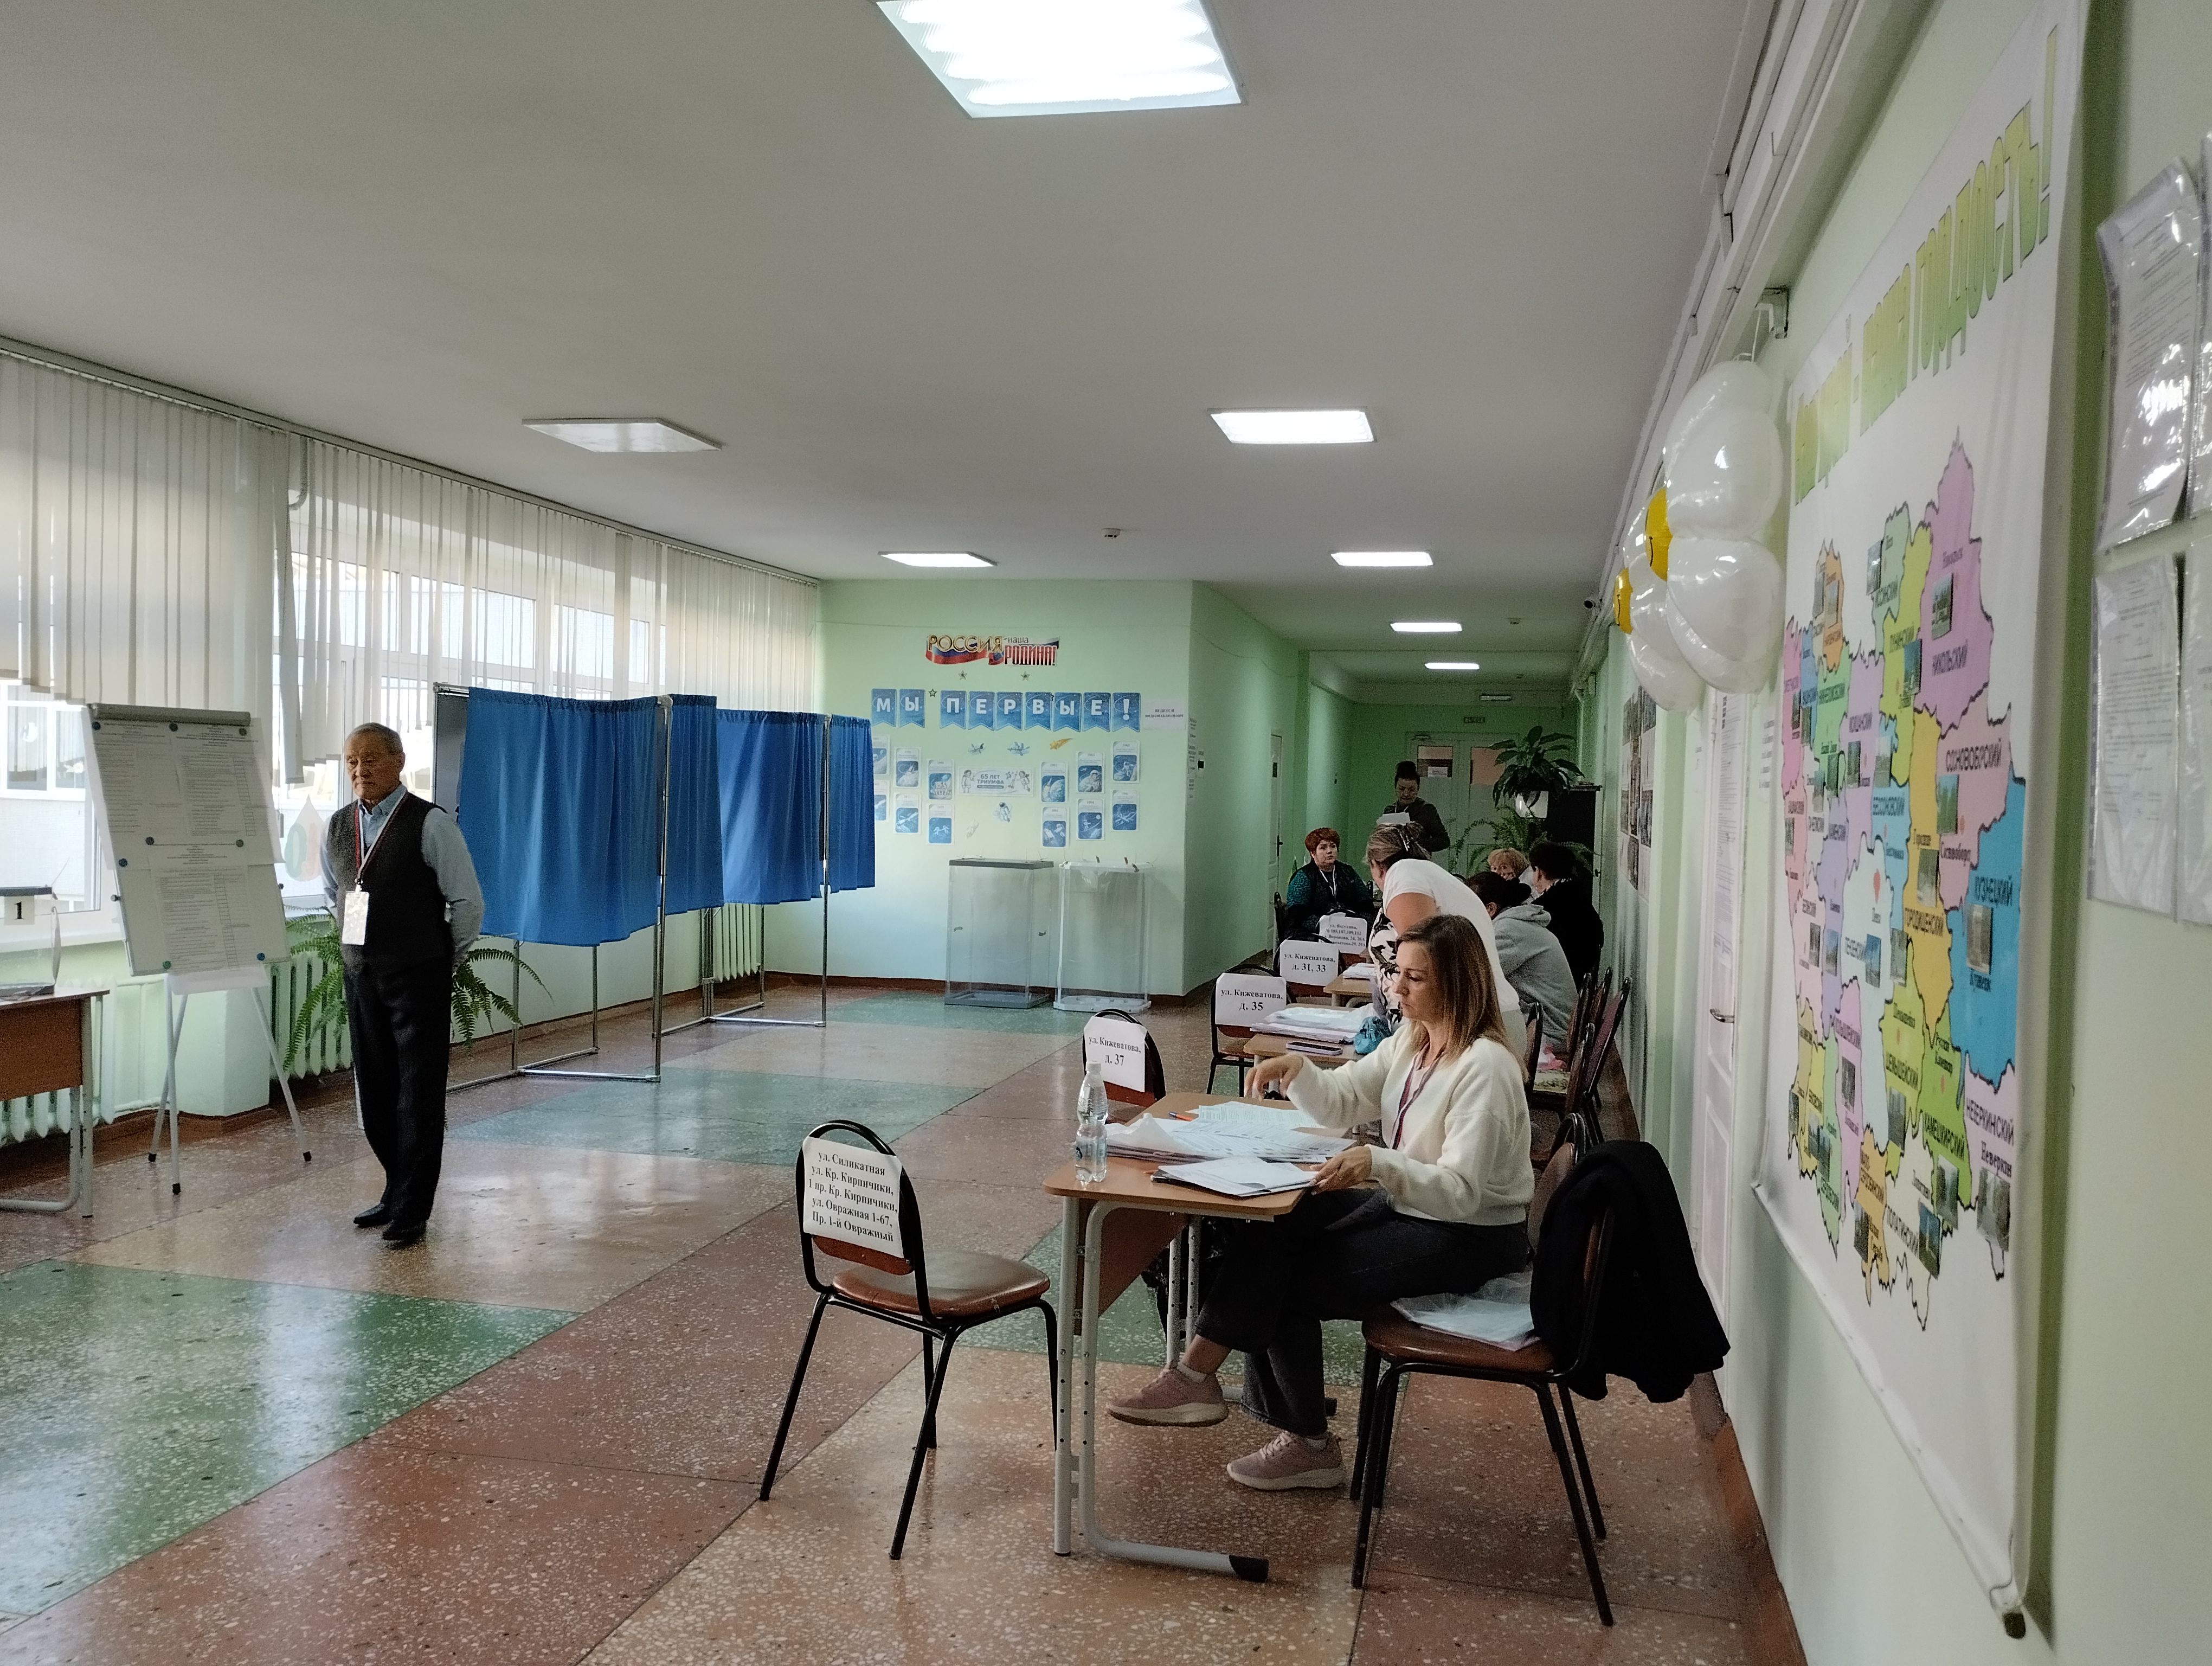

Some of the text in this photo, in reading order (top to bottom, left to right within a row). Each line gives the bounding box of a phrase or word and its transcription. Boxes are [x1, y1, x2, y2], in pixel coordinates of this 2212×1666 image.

[1860, 262, 1911, 437] наша
[1912, 24, 2060, 382] гордость!
[927, 634, 1003, 653] РОССИЯ
[1004, 645, 1057, 667] РОДИНА!
[876, 697, 919, 713] МЫ
[14, 901, 25, 920] 1
[1295, 953, 1336, 963] Кижеватова,
[1301, 963, 1314, 973] 31,
[1316, 964, 1326, 972] 33
[1234, 989, 1283, 1000] Кижеватова,
[1239, 1001, 1264, 1011] д. 35
[1089, 1036, 1141, 1054] ул. Кижеватова,
[1104, 1054, 1124, 1066] д. 37
[818, 1151, 886, 1176] ул. Силикатная
[811, 1165, 894, 1197] ул. Кр. Кирпичики,
[808, 1178, 898, 1214] 1 пр. Кр. Кирпичики,
[812, 1196, 893, 1228] ул. Овражная 1-67,
[812, 1210, 894, 1242] Пр. 1-й Овражный
